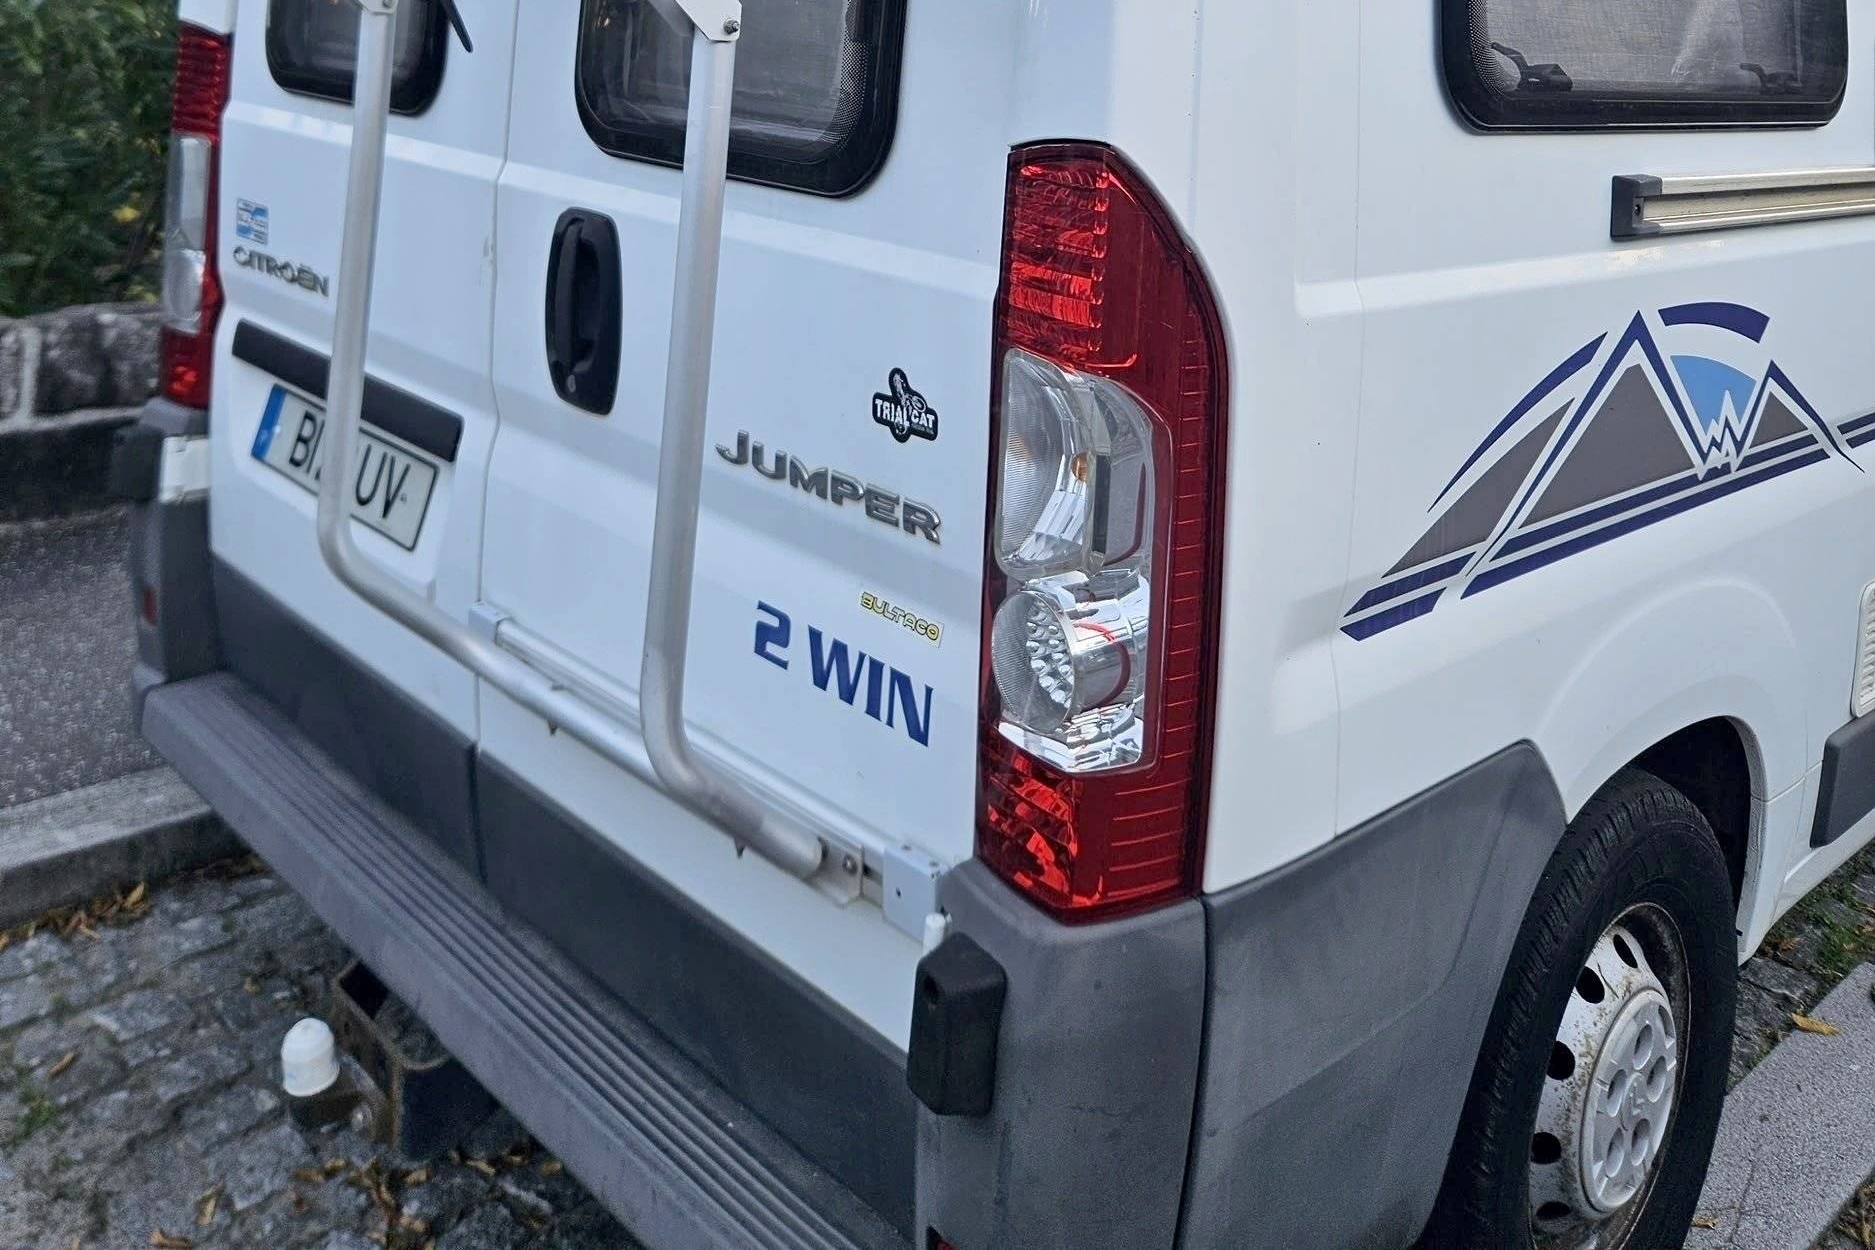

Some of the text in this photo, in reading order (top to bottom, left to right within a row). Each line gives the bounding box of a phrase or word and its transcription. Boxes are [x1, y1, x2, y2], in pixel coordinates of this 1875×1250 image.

[233, 245, 330, 298] CITROËN
[874, 398, 910, 428] TRIAL
[911, 409, 936, 429] CAT
[355, 443, 412, 519] UV
[715, 428, 943, 546] JUMPER
[860, 591, 941, 642] BULTACO
[753, 599, 935, 748] 2 WIN
